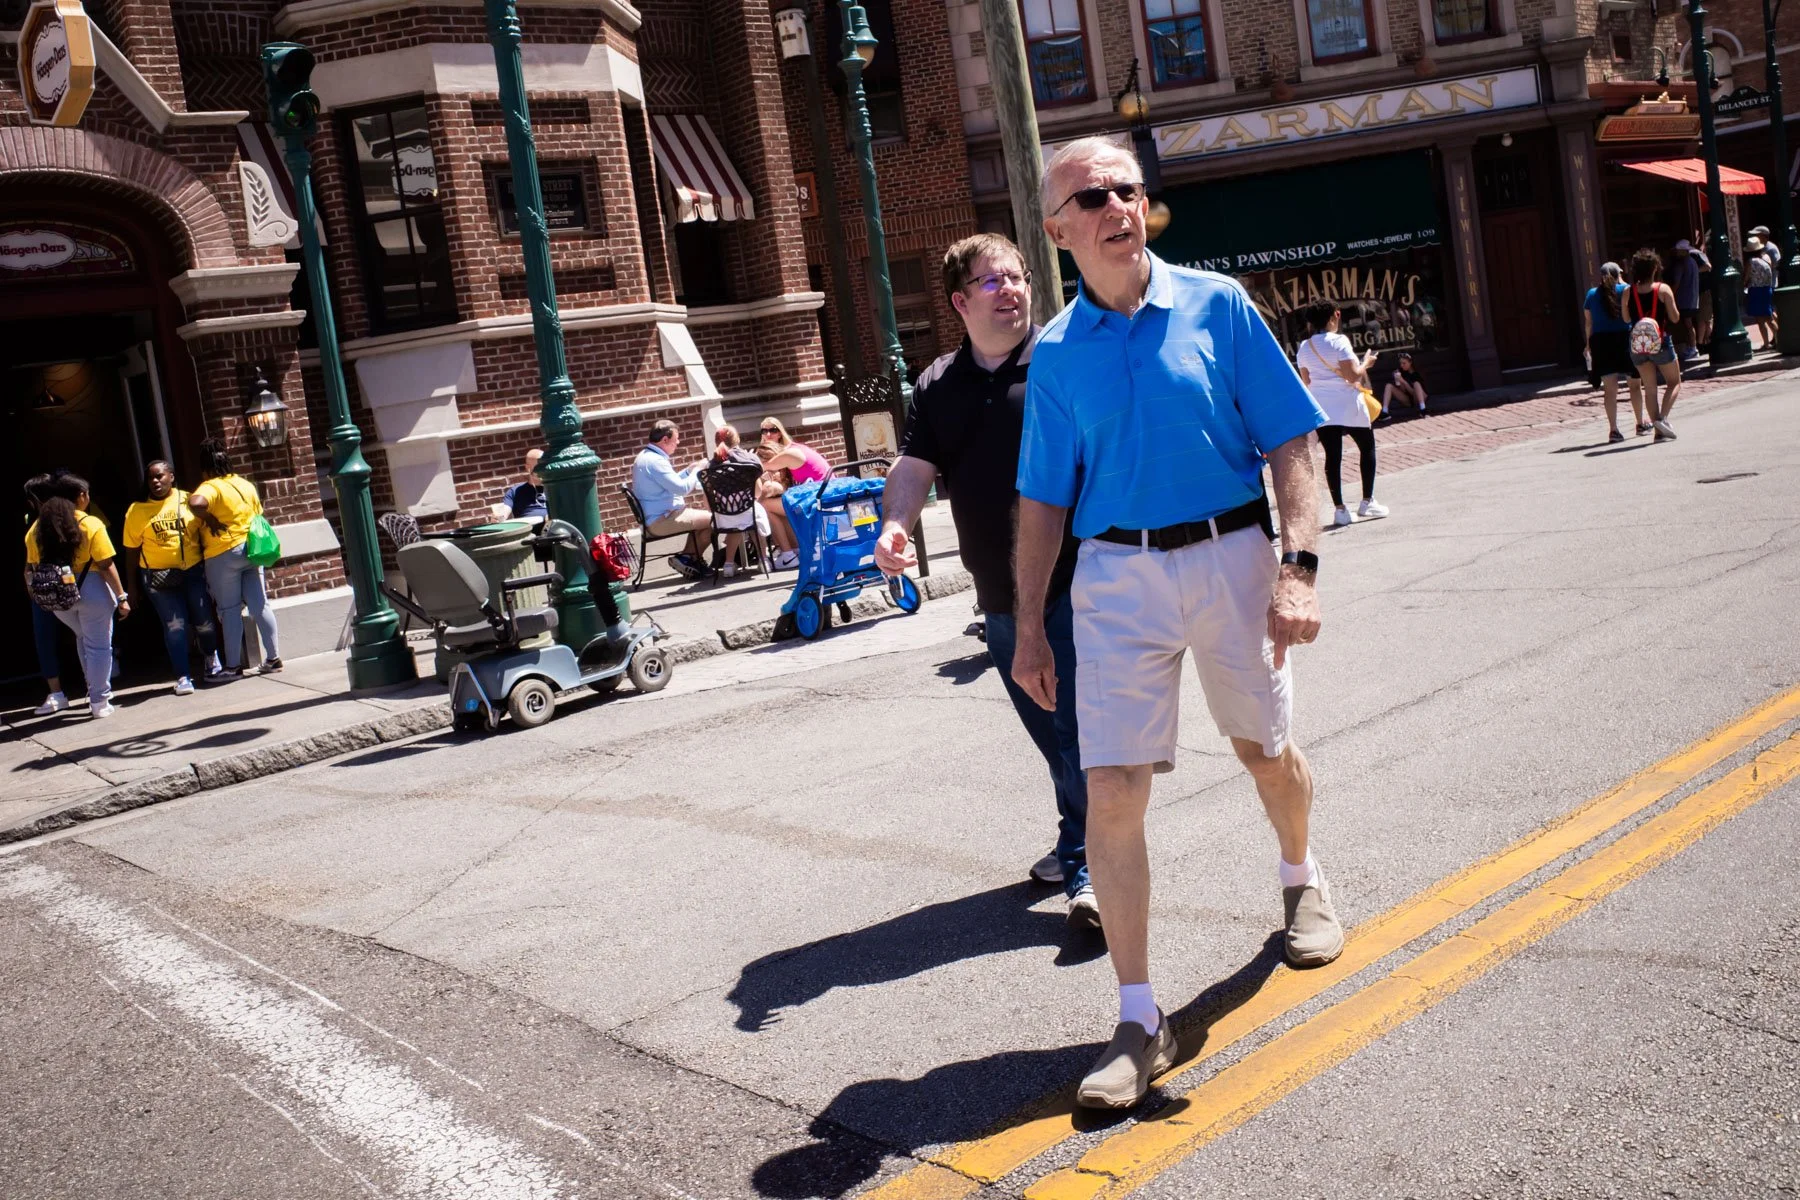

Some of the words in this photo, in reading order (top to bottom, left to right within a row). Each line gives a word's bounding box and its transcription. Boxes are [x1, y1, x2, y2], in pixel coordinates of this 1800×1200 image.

[1159, 76, 1498, 158] ZARMAN
[1717, 97, 1759, 112] DELANCEY
[1760, 95, 1773, 103] ST.
[1236, 241, 1337, 267] PAWNSHOP
[1417, 229, 1436, 239] 109
[1250, 267, 1420, 321] NAZARMAN'S
[1352, 325, 1416, 348] RGAINS
